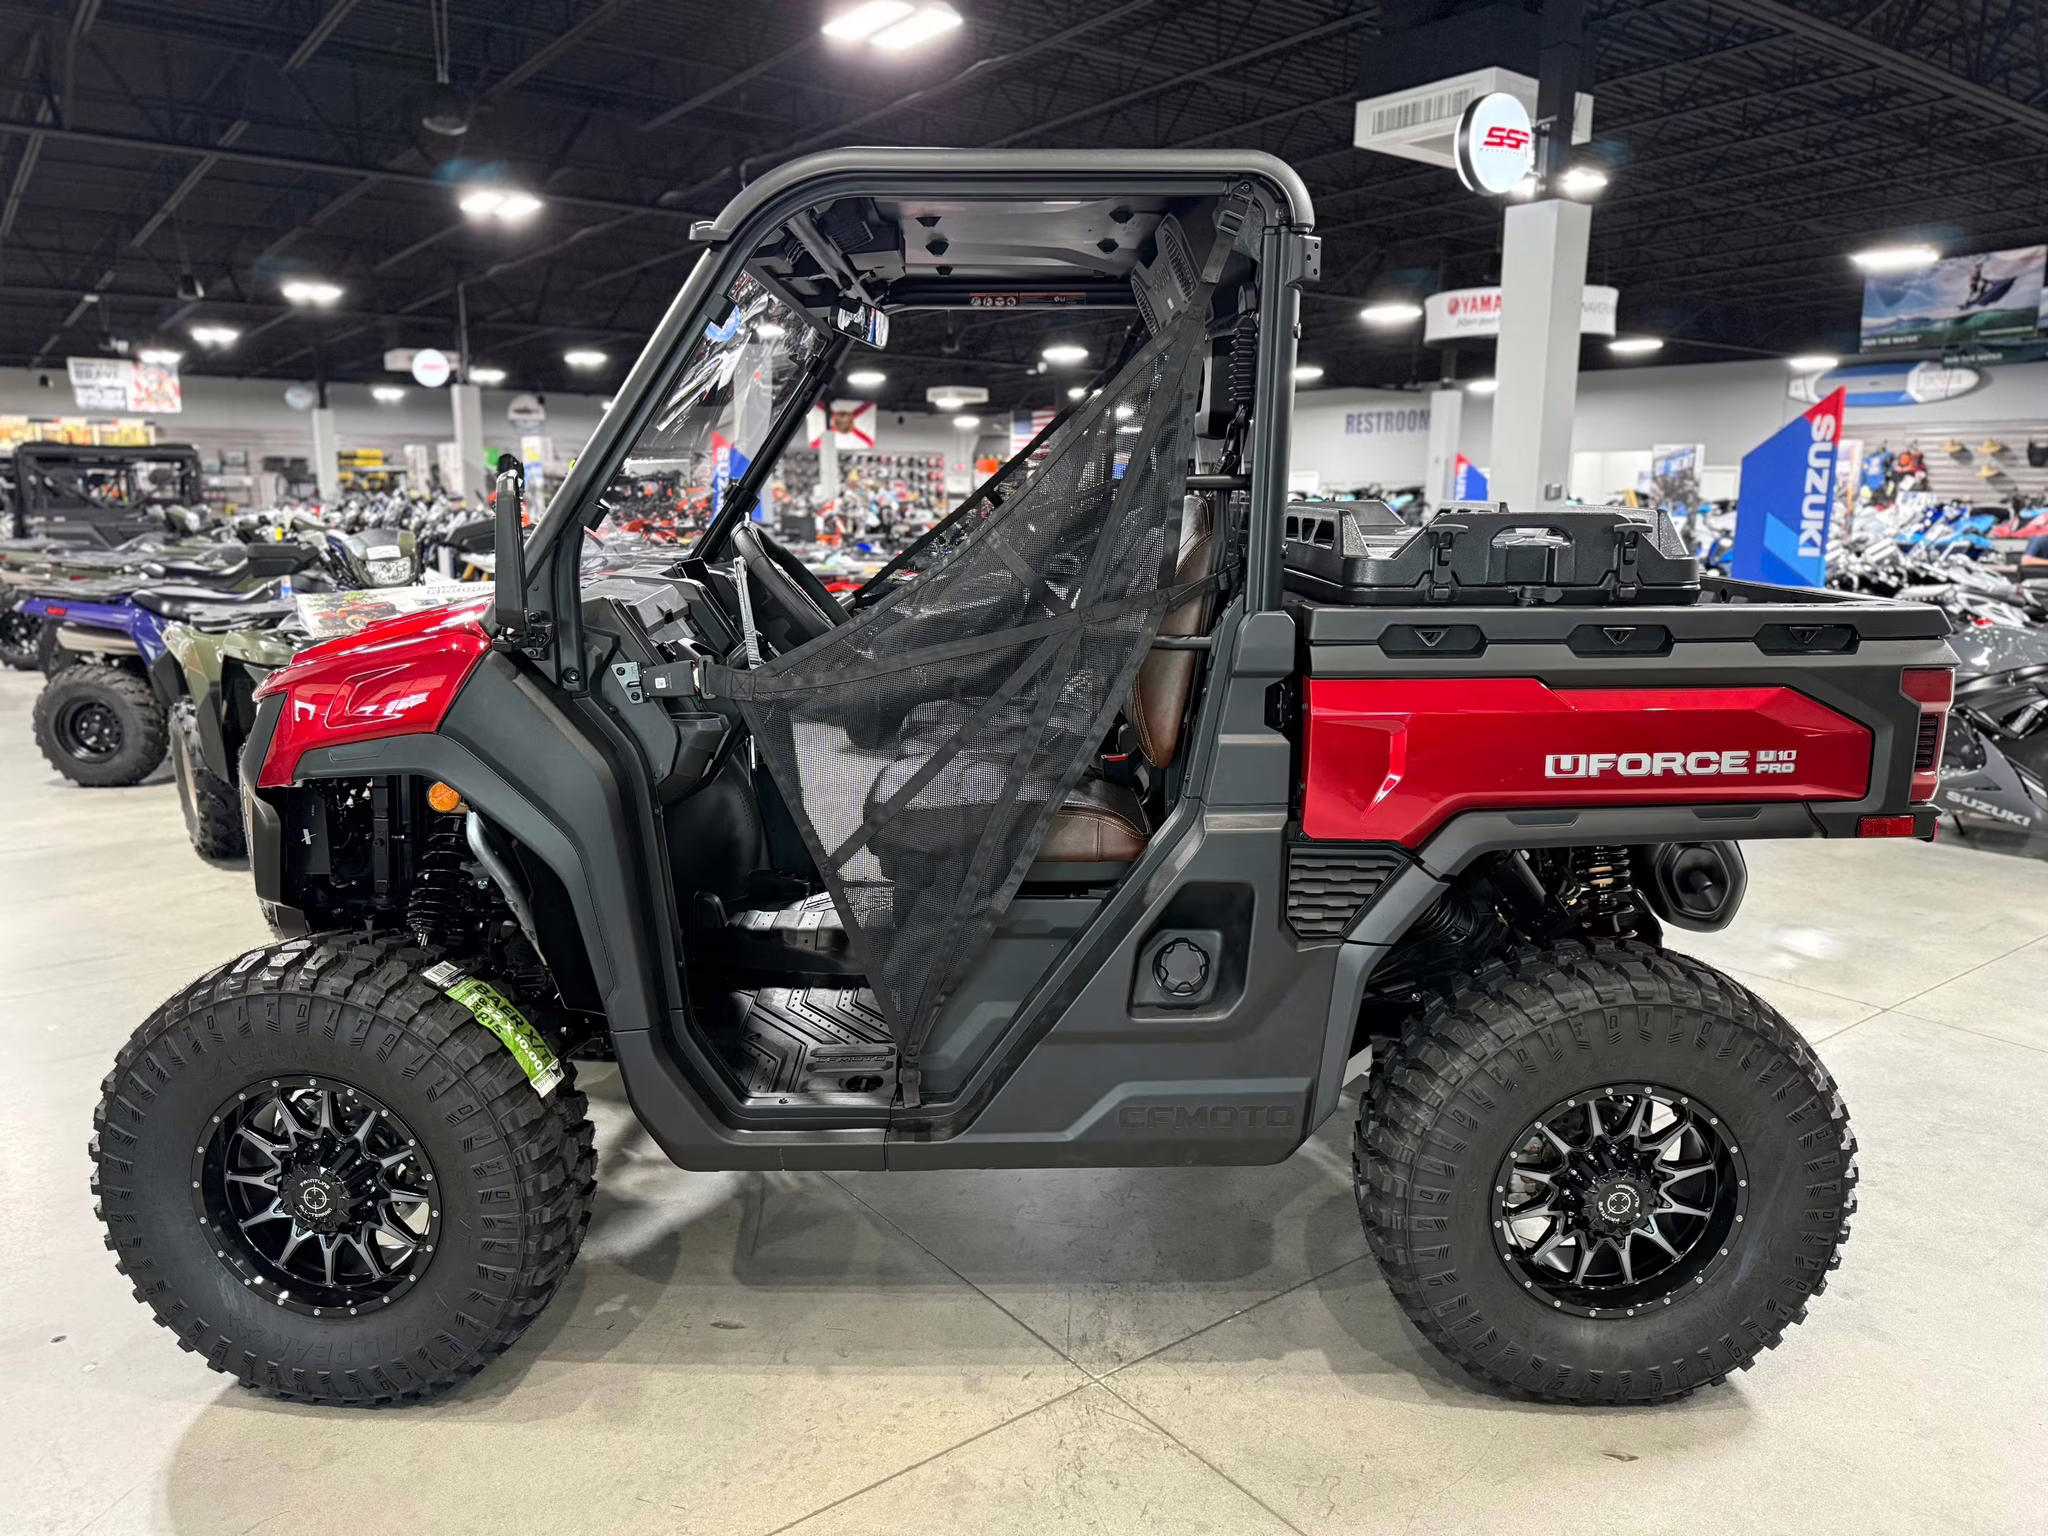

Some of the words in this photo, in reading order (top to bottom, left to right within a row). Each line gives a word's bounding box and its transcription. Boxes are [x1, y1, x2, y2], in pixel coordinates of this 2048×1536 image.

[1462, 295, 1503, 314] YAMA
[1798, 413, 1836, 558] SUZUKI
[1755, 763, 1795, 774] PRO
[1946, 791, 2031, 827] SUZUKI
[473, 983, 525, 1029] BAER
[523, 1028, 553, 1062] X/T
[514, 1033, 544, 1072] 10.00
[1119, 1105, 1296, 1128] CFMOTO
[299, 1178, 330, 1190] FRONTLINE
